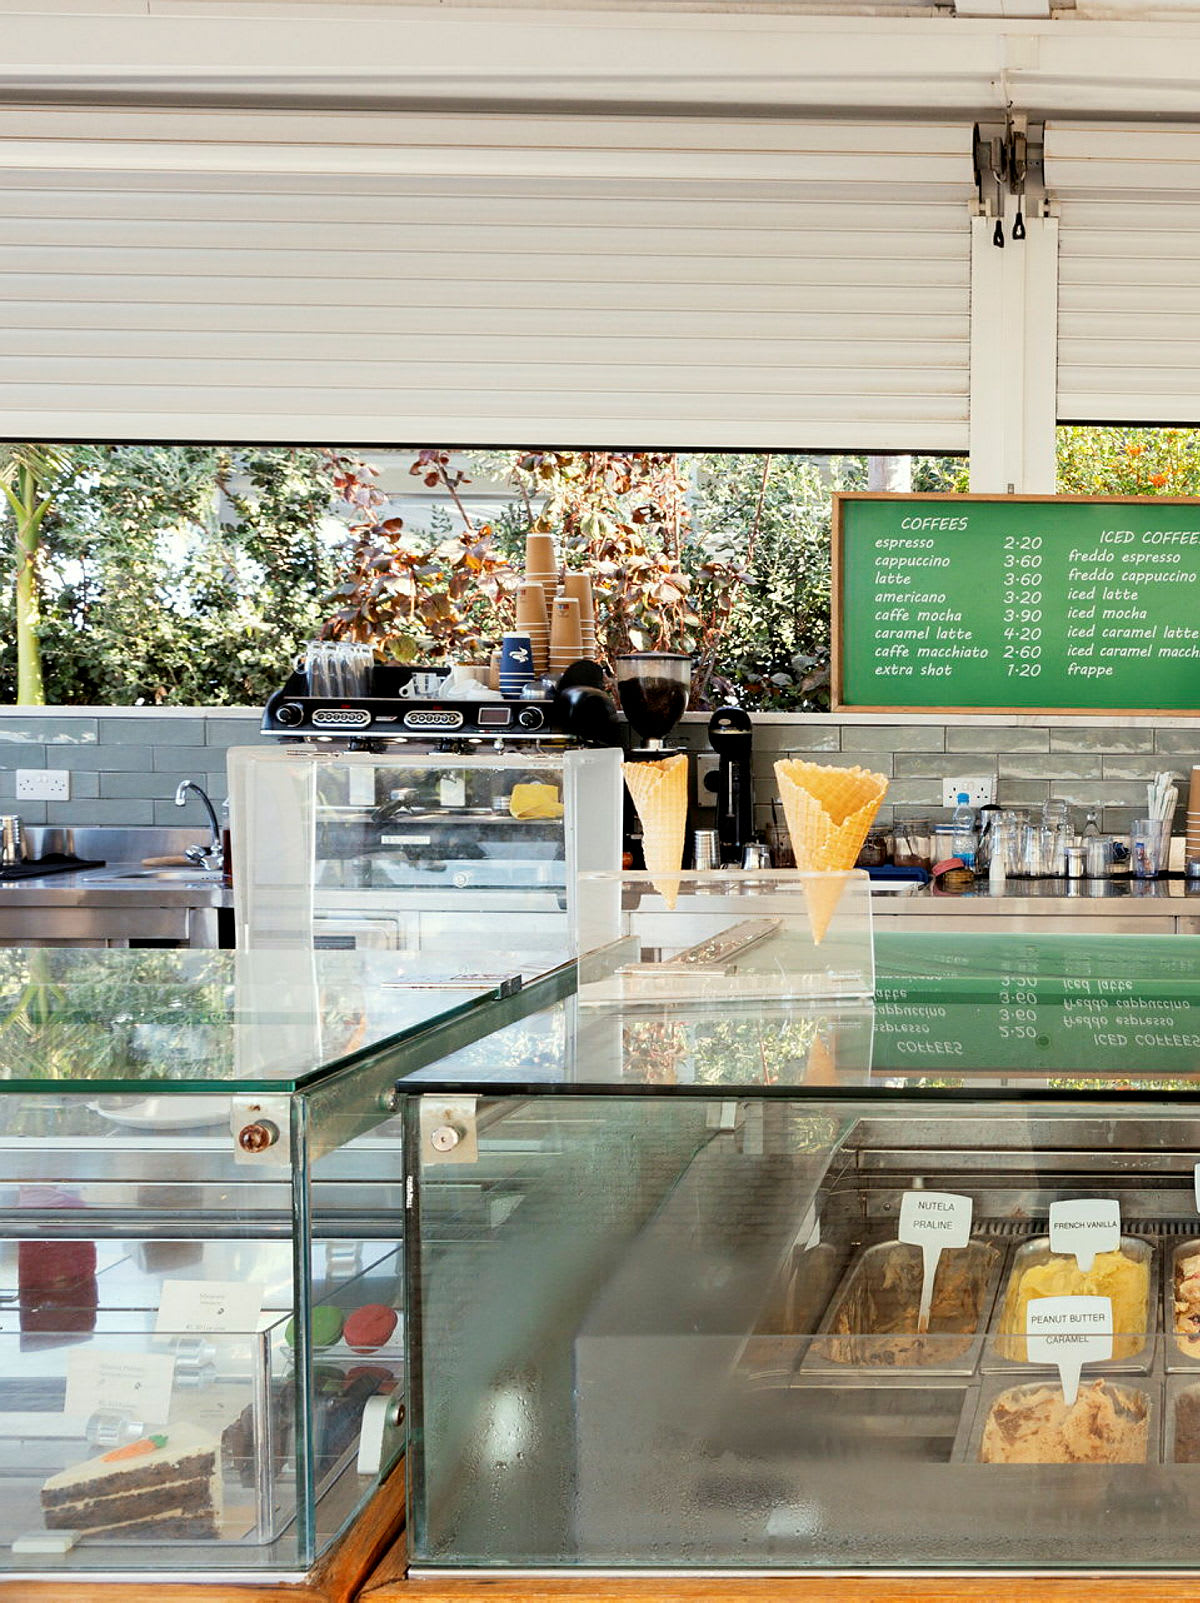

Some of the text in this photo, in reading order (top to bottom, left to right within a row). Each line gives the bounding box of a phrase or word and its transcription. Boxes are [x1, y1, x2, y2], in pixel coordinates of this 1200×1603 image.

[901, 517, 968, 530] COFFEES
[1100, 531, 1134, 543] ICED
[875, 539, 934, 550] espresso
[875, 555, 950, 569] cappuccino
[1069, 549, 1114, 562] freddo
[1122, 554, 1180, 565] espresso
[875, 571, 911, 584] latte
[1069, 568, 1114, 580] freddo
[1122, 570, 1196, 584] cappuccino
[875, 591, 945, 603] americano
[1068, 586, 1095, 599] iced
[1103, 587, 1137, 600] latte
[875, 608, 909, 621] caffe
[918, 609, 961, 621] mocha
[1068, 605, 1095, 618] iced
[1103, 607, 1147, 619] mocha
[875, 626, 929, 639] caramel
[937, 627, 972, 639] latte
[1068, 624, 1095, 637] iced
[1102, 626, 1157, 638] caramel
[1164, 625, 1198, 638] latte
[875, 645, 909, 657] caffe
[918, 645, 988, 658] macchiato
[1068, 643, 1094, 656] iced
[1100, 644, 1152, 657] caramel
[875, 664, 913, 675] extra
[920, 663, 952, 675] shot
[1068, 663, 1112, 678] frappe
[918, 1202, 954, 1211] NUTELA
[914, 1220, 952, 1230] PRALINE
[1054, 1220, 1117, 1230] FRENCH VANILLA
[1032, 1313, 1104, 1324] PEANUT BUTTER
[1046, 1334, 1089, 1344] CARAMEL
